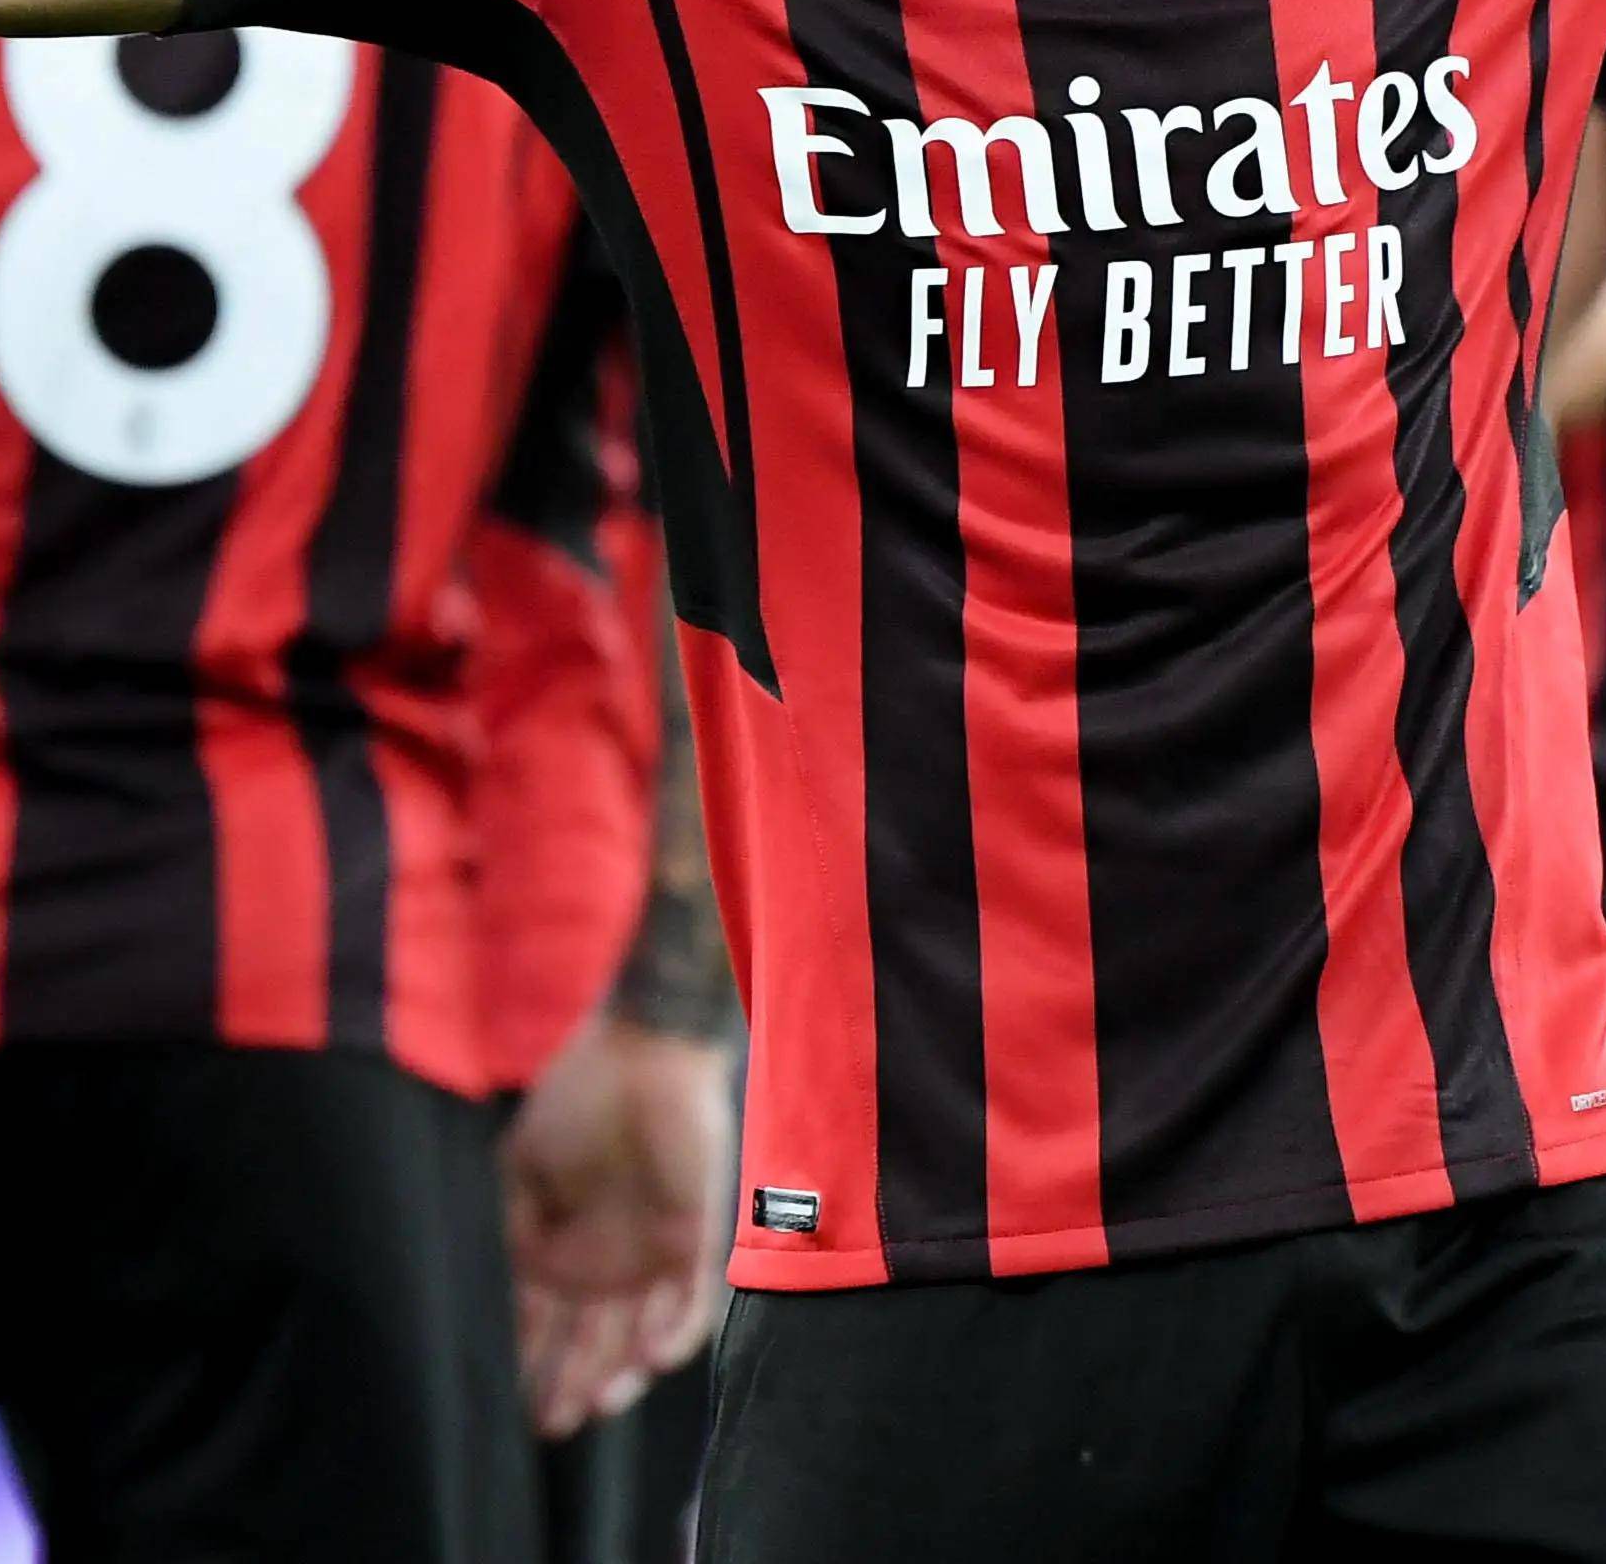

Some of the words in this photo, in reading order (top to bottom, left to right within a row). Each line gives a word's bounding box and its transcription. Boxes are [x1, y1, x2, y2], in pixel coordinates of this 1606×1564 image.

[757, 53, 1478, 238] Emirates
[907, 264, 1057, 388] FLY
[1101, 224, 1407, 384] BETTER
